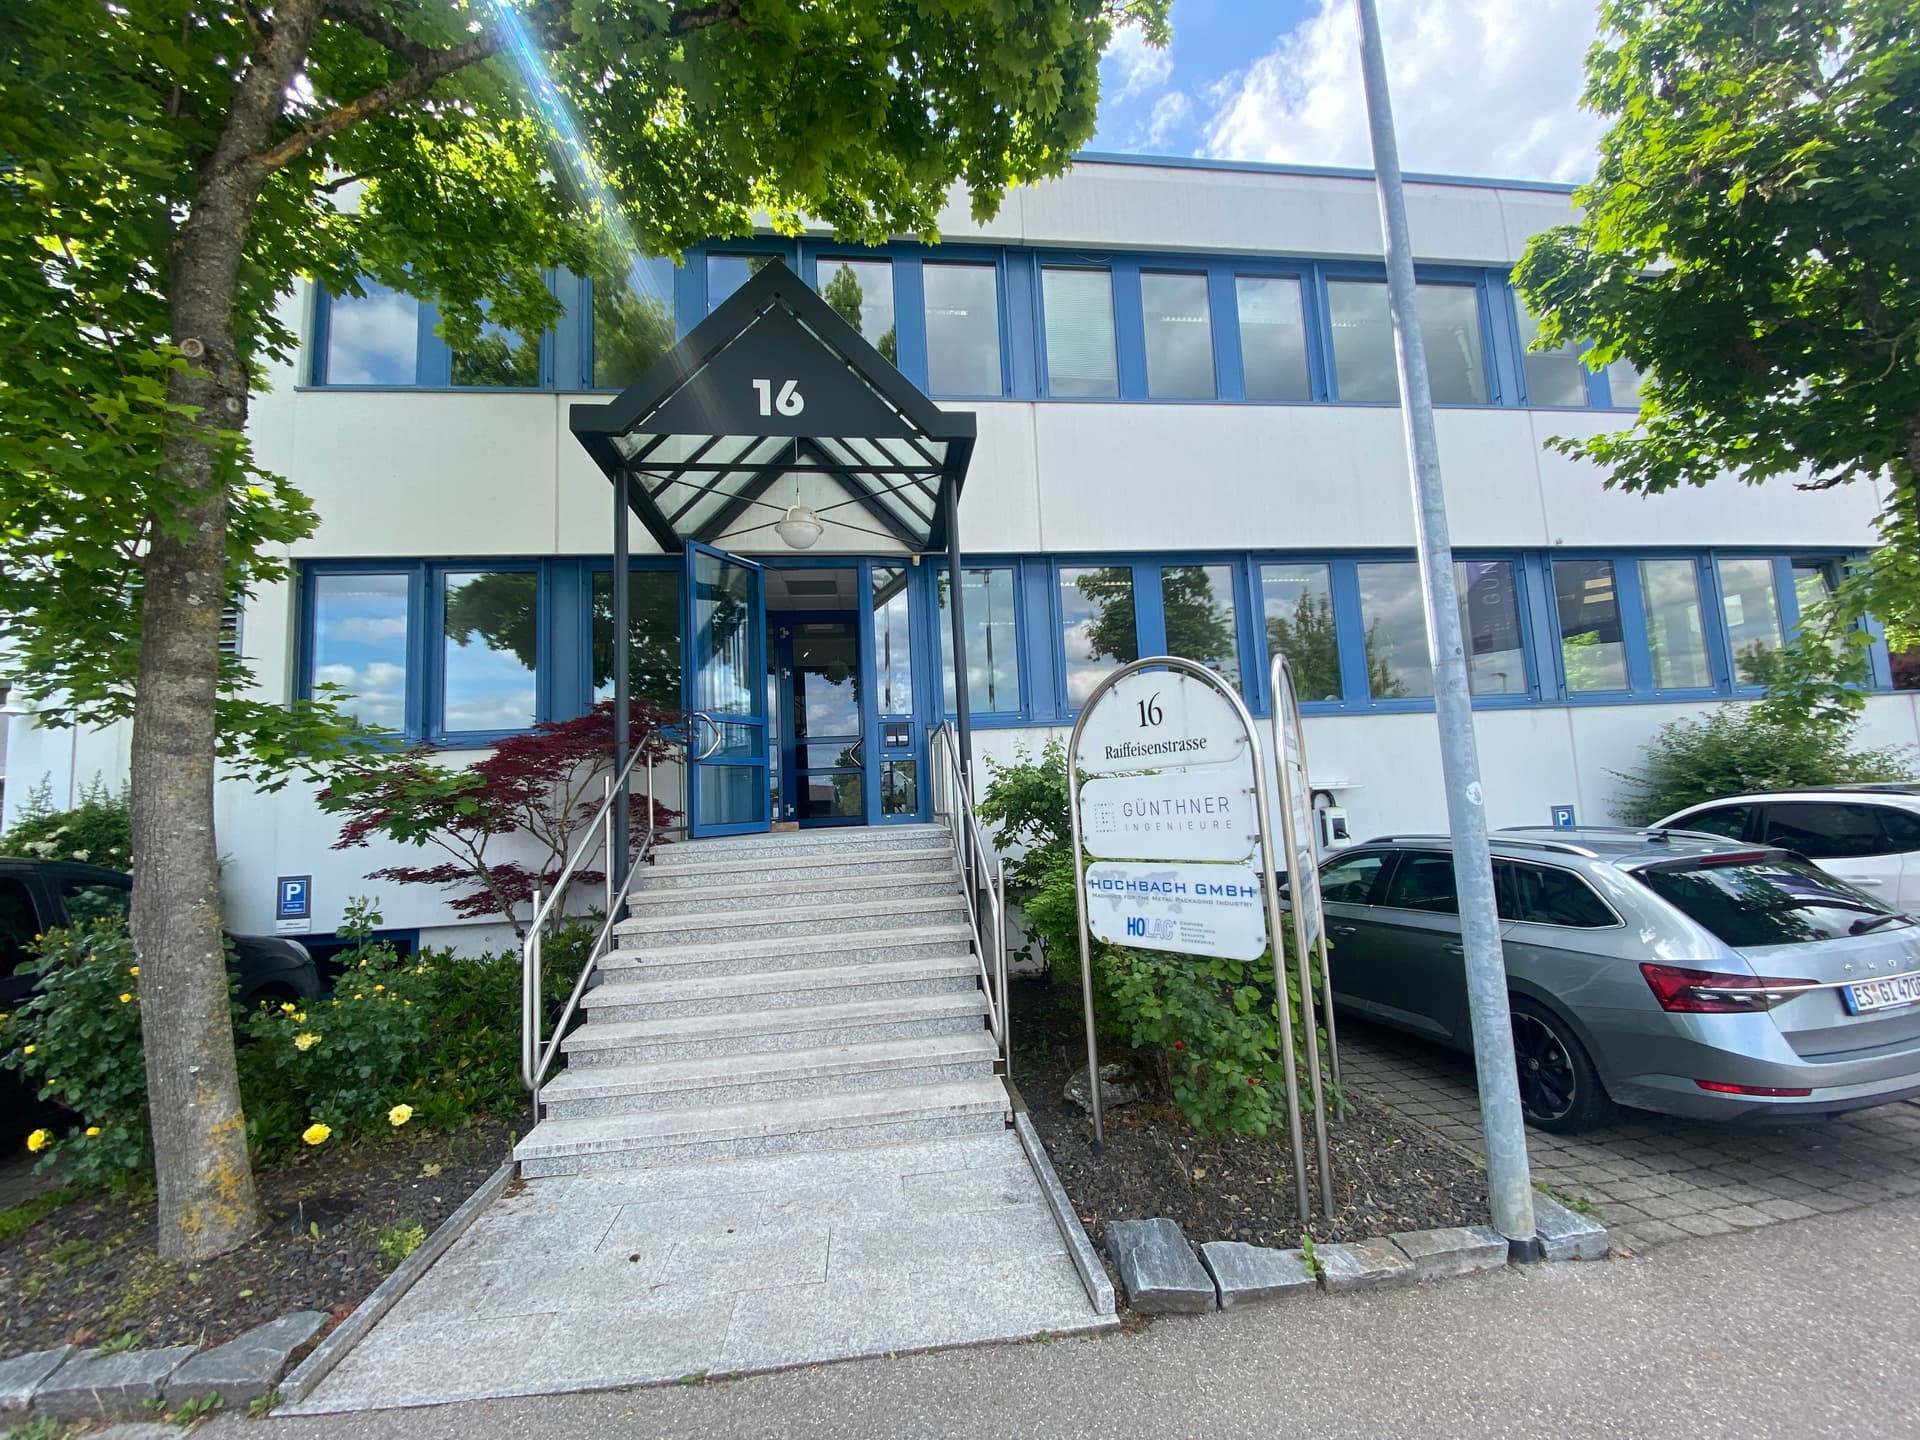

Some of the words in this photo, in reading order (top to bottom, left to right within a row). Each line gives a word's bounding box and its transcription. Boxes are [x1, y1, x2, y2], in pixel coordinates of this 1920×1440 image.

[752, 379, 804, 416] 16
[1137, 691, 1162, 728] 16
[1105, 737, 1207, 759] Raiffeisenstrasse
[1123, 797, 1230, 816] GÜNTHNER
[1125, 820, 1232, 832] INGENIEURE
[1558, 811, 1569, 826] P
[287, 884, 301, 901] P
[1091, 880, 1186, 894] HOCHBACH
[1195, 883, 1253, 898] GMBH
[1853, 986, 1874, 1006] ES
